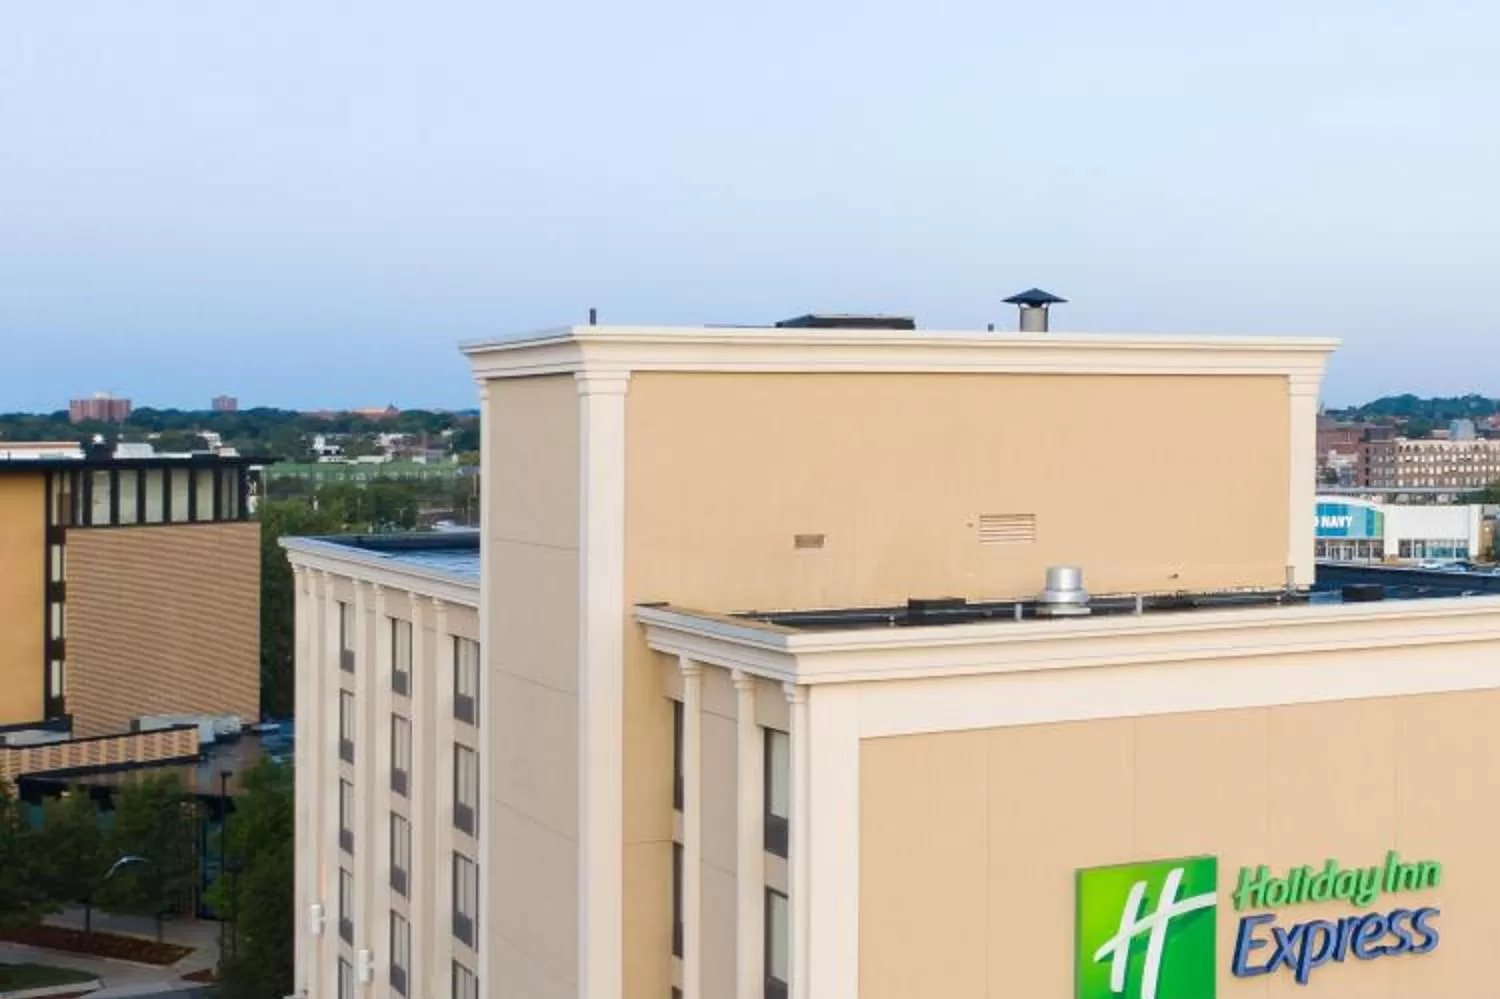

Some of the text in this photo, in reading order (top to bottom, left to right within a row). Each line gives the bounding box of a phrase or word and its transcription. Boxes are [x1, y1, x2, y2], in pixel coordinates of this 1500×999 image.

[1321, 515, 1353, 528] NAVY
[1232, 850, 1442, 911] Holiday Inn
[1231, 907, 1441, 986] Express
